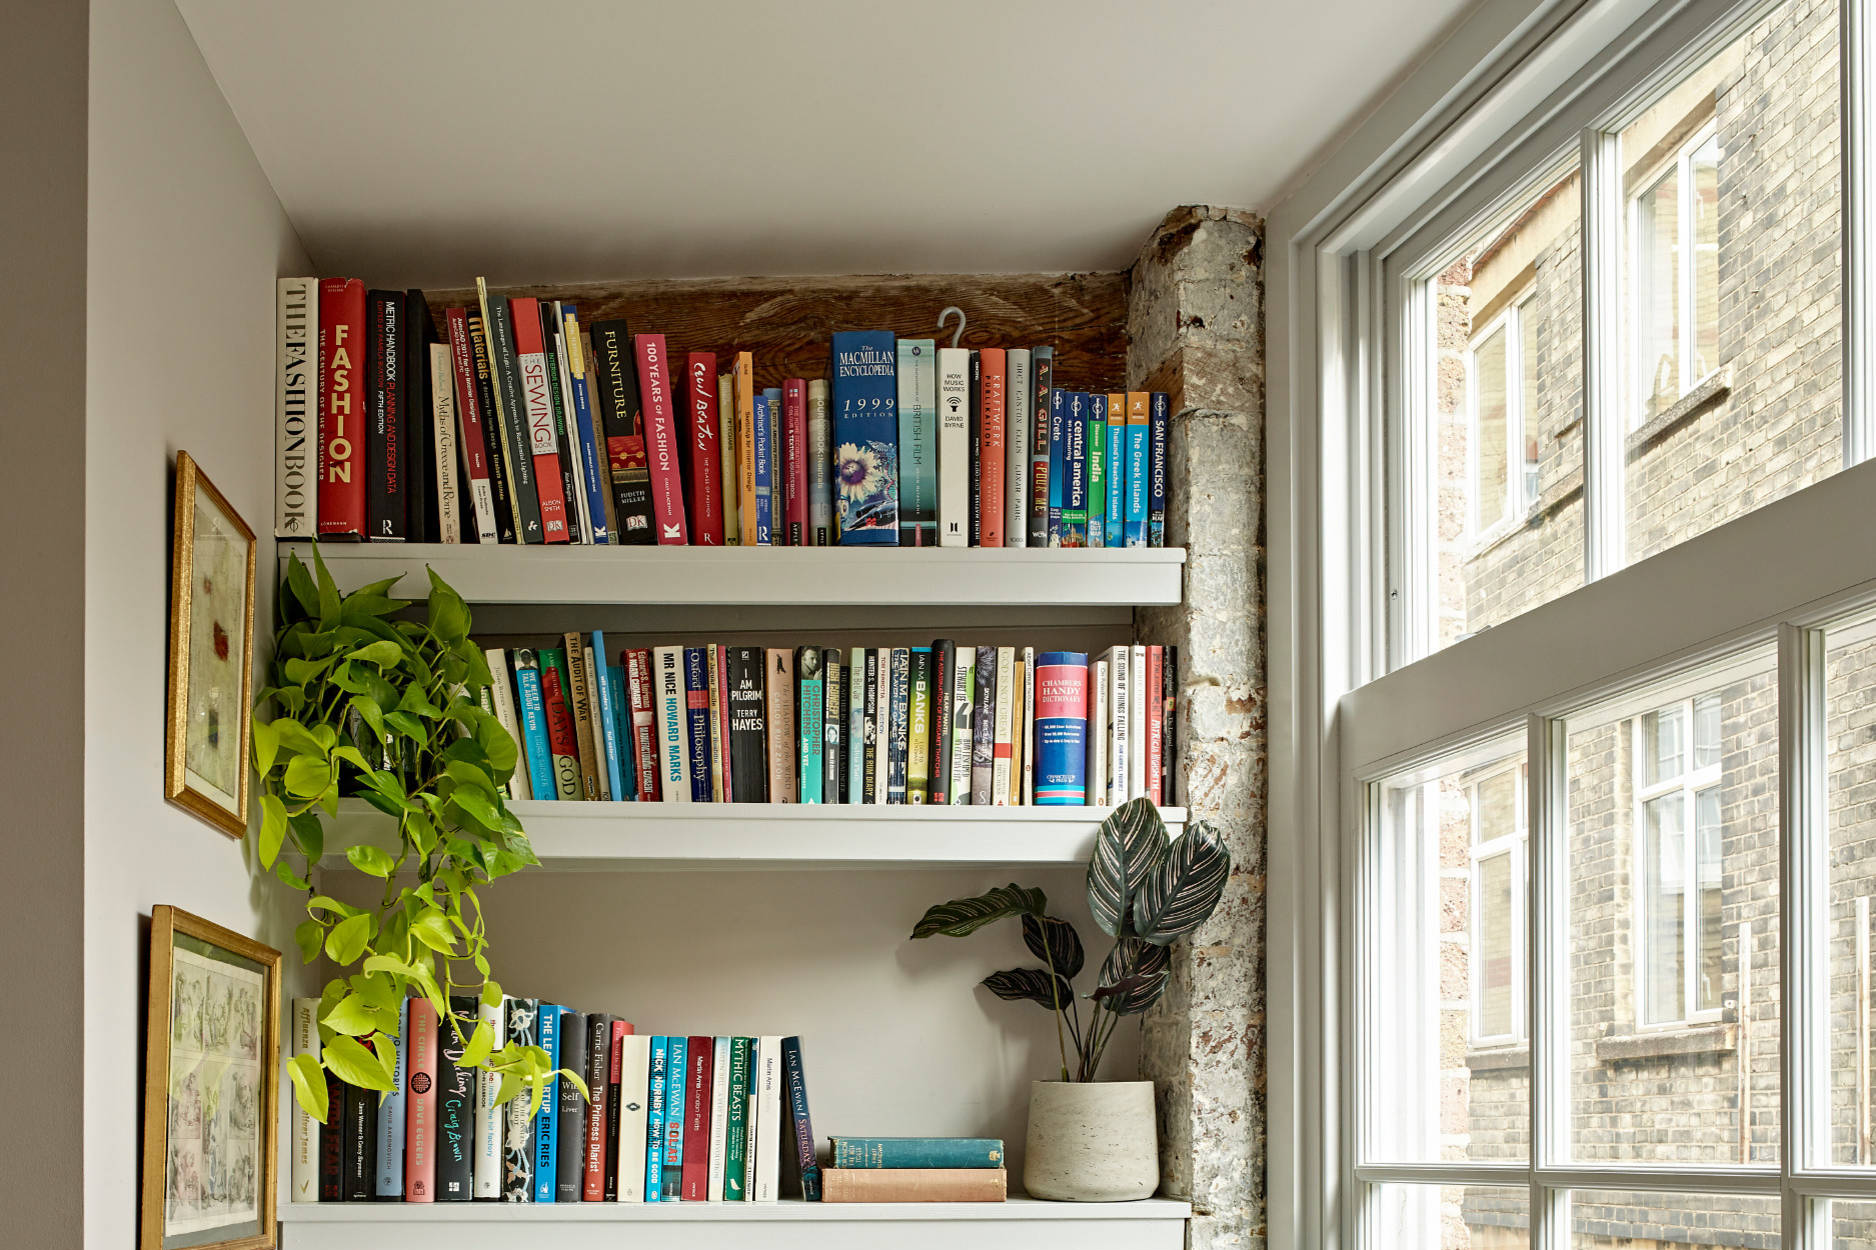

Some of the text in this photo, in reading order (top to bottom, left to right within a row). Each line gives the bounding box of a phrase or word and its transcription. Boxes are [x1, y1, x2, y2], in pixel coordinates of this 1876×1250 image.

[469, 317, 490, 380] Materials
[646, 342, 658, 363] 100
[840, 352, 894, 364] MACMILLAN
[604, 330, 627, 419] FURNITURE
[648, 364, 661, 402] YEARS
[840, 364, 894, 376] ENCYCLOPEDIA
[330, 325, 352, 482] FASHION
[385, 301, 396, 494] METRIC HANDBOOK PLANNING AND DESIGN DATA
[548, 352, 564, 436] INTERIOR DESIGN DRAWING
[992, 376, 1000, 447] KRAFTWERK
[1037, 364, 1049, 451] A. A. GILL
[756, 404, 766, 474] Architect's Pocket Book
[912, 404, 922, 442] BRITISH
[1053, 416, 1061, 441] Crete
[655, 417, 670, 472] FASHION
[912, 444, 922, 465] FILM
[1072, 420, 1084, 506] central america
[1112, 428, 1120, 460] Thailand's
[1154, 420, 1164, 498] SAN FRANCISCO
[1092, 451, 1102, 482] India
[1112, 462, 1120, 488] Beaches
[1132, 432, 1142, 514] The Greek Islands
[1034, 467, 1048, 512] POUR ME
[1112, 496, 1120, 521] Islands
[529, 672, 540, 711] WE NEED TO
[570, 638, 588, 722] THE AUDIT OF WAR
[731, 690, 762, 700] PILGRIM
[740, 680, 752, 690] AM
[829, 662, 840, 720] HIGH CONCEPT
[956, 666, 968, 702] STEWART LEE
[1000, 652, 1009, 738] GOD IS NOT GREAT
[1042, 687, 1080, 696] HANDY
[1117, 650, 1126, 741] THE SOUND OF THINGS FALLING
[522, 672, 537, 731] TALK ABOUT KEVIN
[663, 652, 682, 782] MR NICE HOWARD MARKS
[690, 652, 707, 780] Oxford Philosophy
[736, 709, 758, 718] TERRY
[812, 685, 820, 756] CHRISTOPHER
[898, 654, 909, 750] IAIN M. BANKS
[936, 706, 943, 714] OF
[551, 700, 570, 745] DAYS
[732, 718, 763, 730] HAYES
[1151, 720, 1160, 752] PATRICIA
[558, 756, 576, 796] GOD
[865, 776, 873, 796] DIARY
[1151, 754, 1160, 790] HIGHSMITH
[300, 1007, 310, 1048] Affluenza
[418, 1013, 426, 1068] THE CIRCLE
[544, 1014, 553, 1035] THE
[542, 1038, 552, 1056] LEA
[673, 1044, 683, 1064] IAN
[732, 1038, 744, 1082] MYTHIC
[562, 1093, 580, 1101] Self
[590, 1022, 604, 1172] Carrie Fisher The Princess Diarist
[732, 1084, 742, 1121] BEASTS
[789, 1050, 798, 1066] IAN
[798, 1118, 812, 1162] SATURDAY
[325, 1084, 340, 1176] WITH FEAR
[416, 1098, 425, 1166] DAVE EGGERS
[541, 1116, 550, 1141] ERIC
[667, 1122, 680, 1163] SOLAR
[300, 1138, 309, 1164] James
[540, 1144, 550, 1168] RIES
